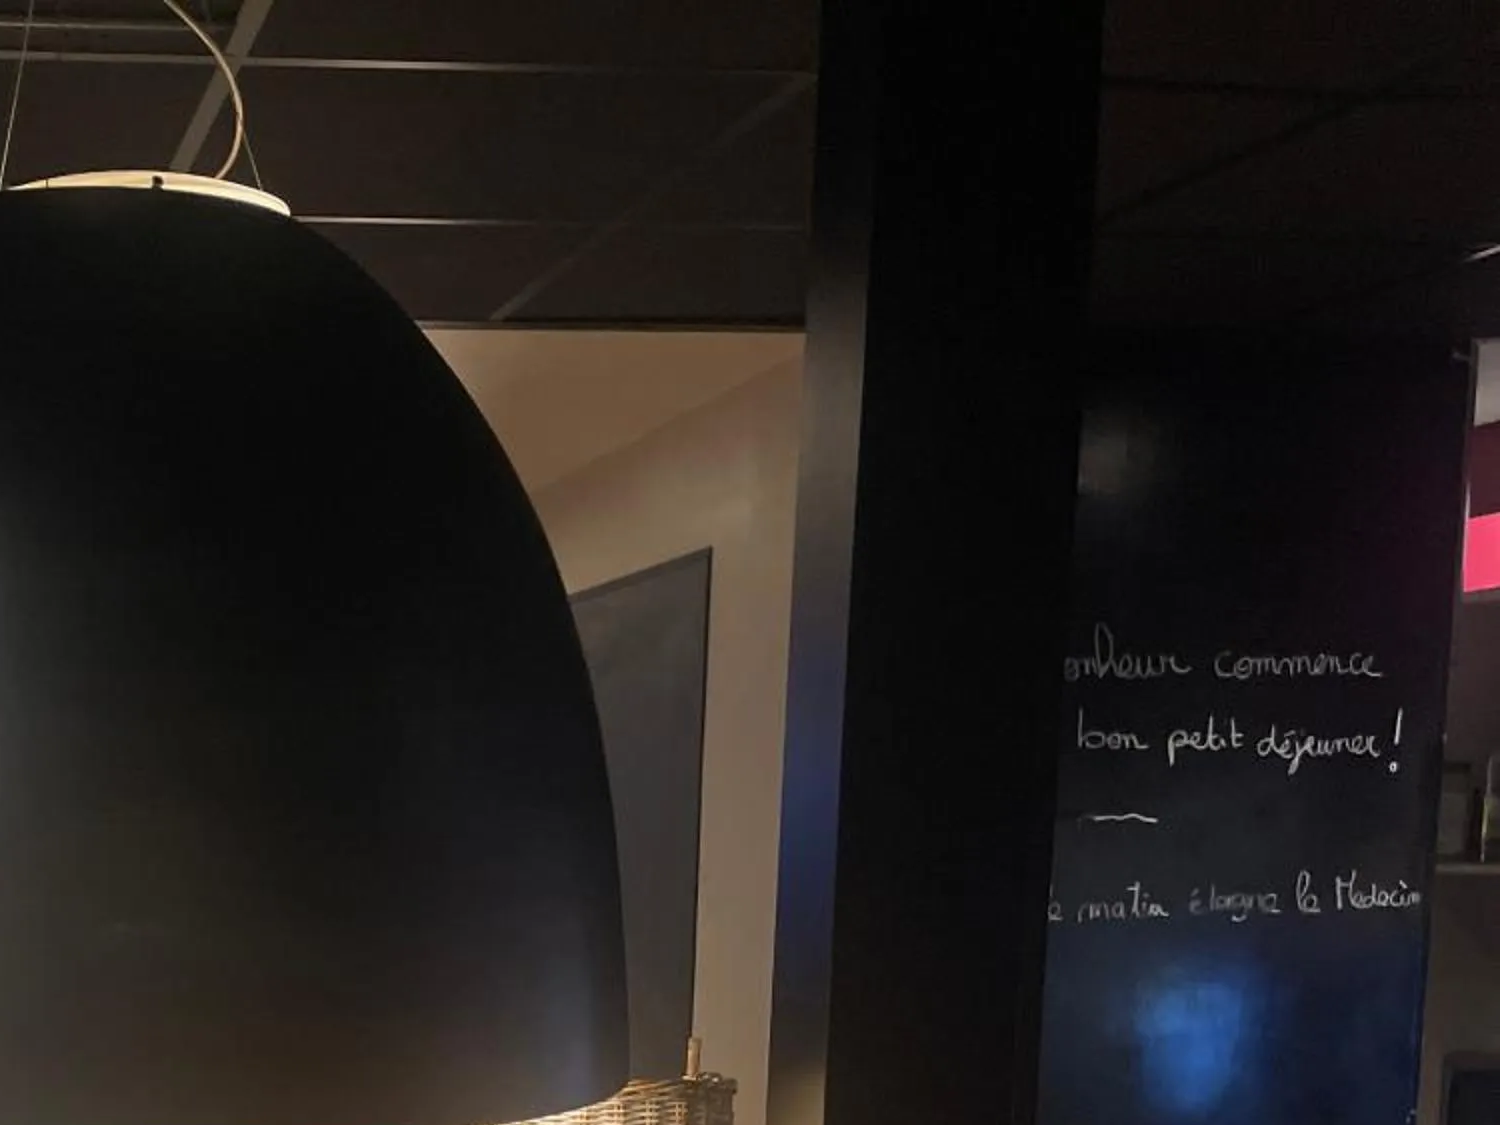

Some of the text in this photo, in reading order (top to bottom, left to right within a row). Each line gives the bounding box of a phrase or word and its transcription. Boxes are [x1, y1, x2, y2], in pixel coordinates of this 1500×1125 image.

[1063, 622, 1384, 682] onheur commence
[1077, 708, 1149, 750] bon
[1167, 714, 1244, 767] petit
[1296, 869, 1321, 913] le
